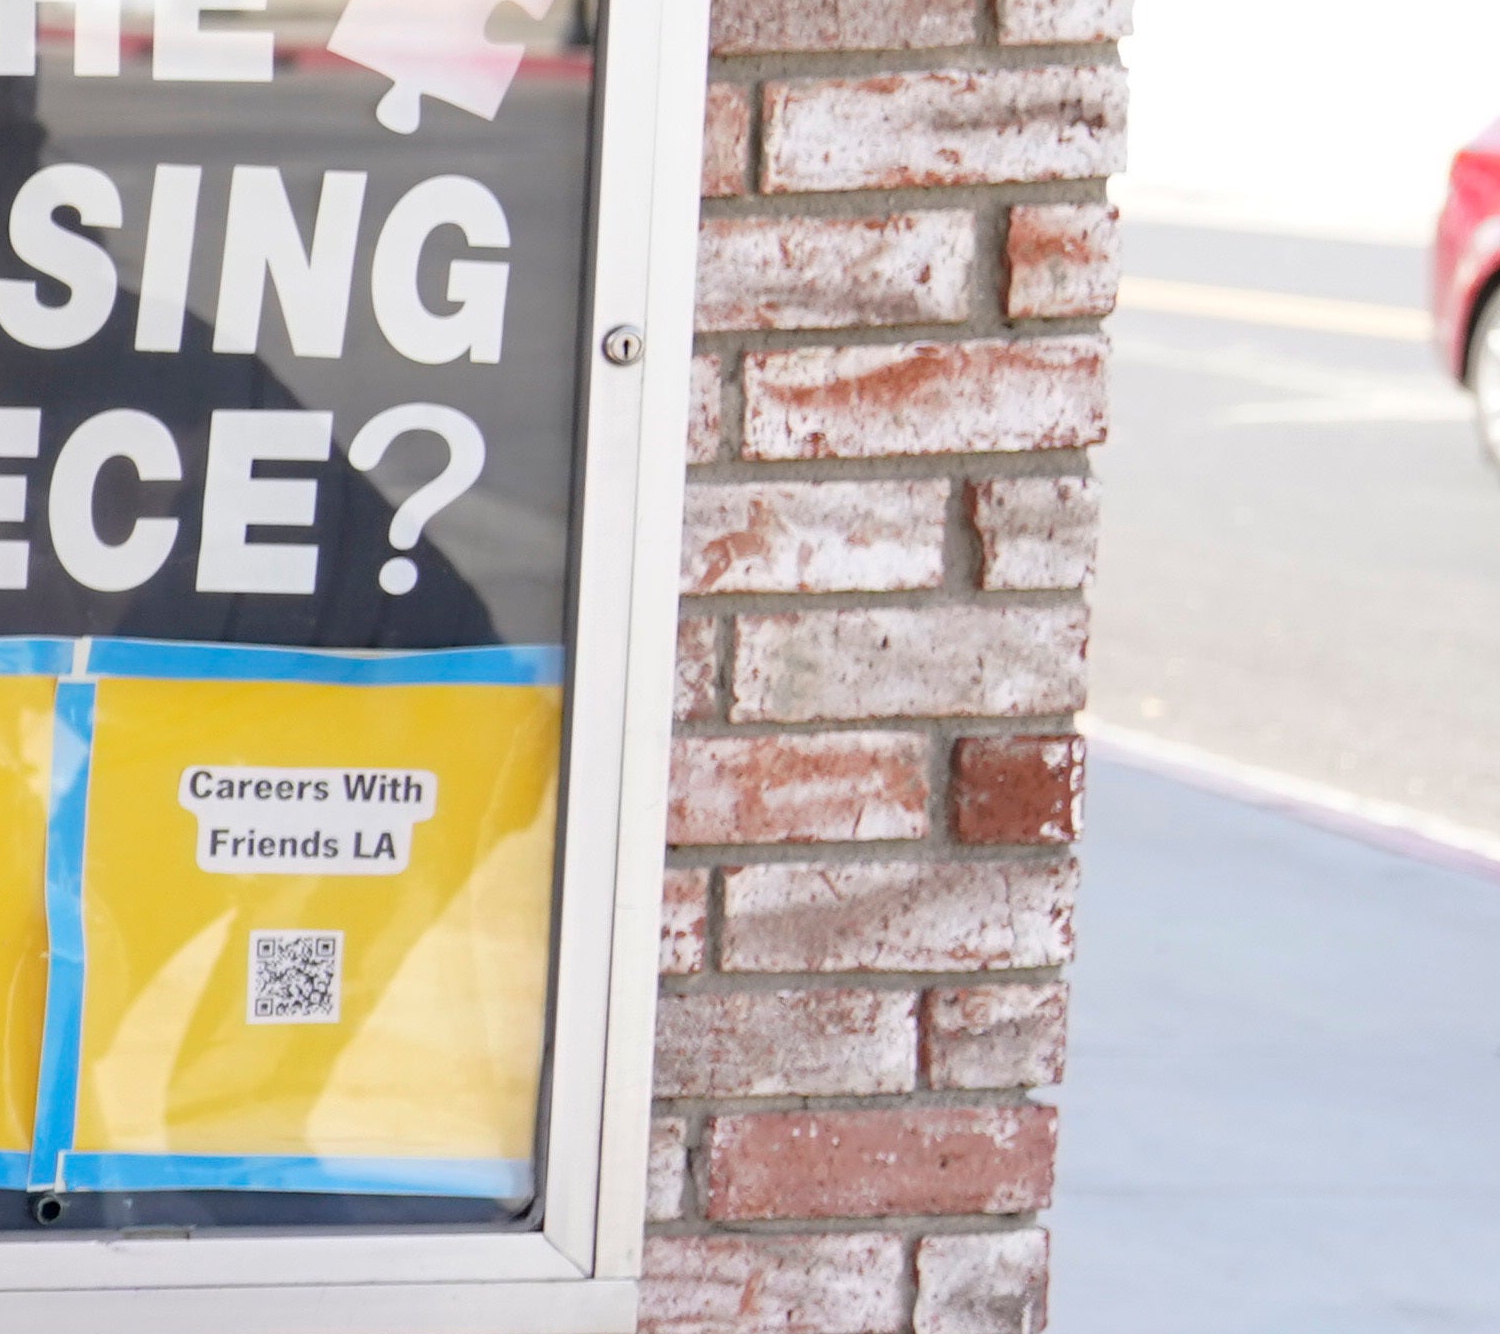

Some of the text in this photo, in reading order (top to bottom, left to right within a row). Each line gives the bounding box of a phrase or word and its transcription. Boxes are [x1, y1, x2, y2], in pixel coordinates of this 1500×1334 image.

[189, 770, 422, 804] Careers With
[209, 828, 397, 860] Friends LA
